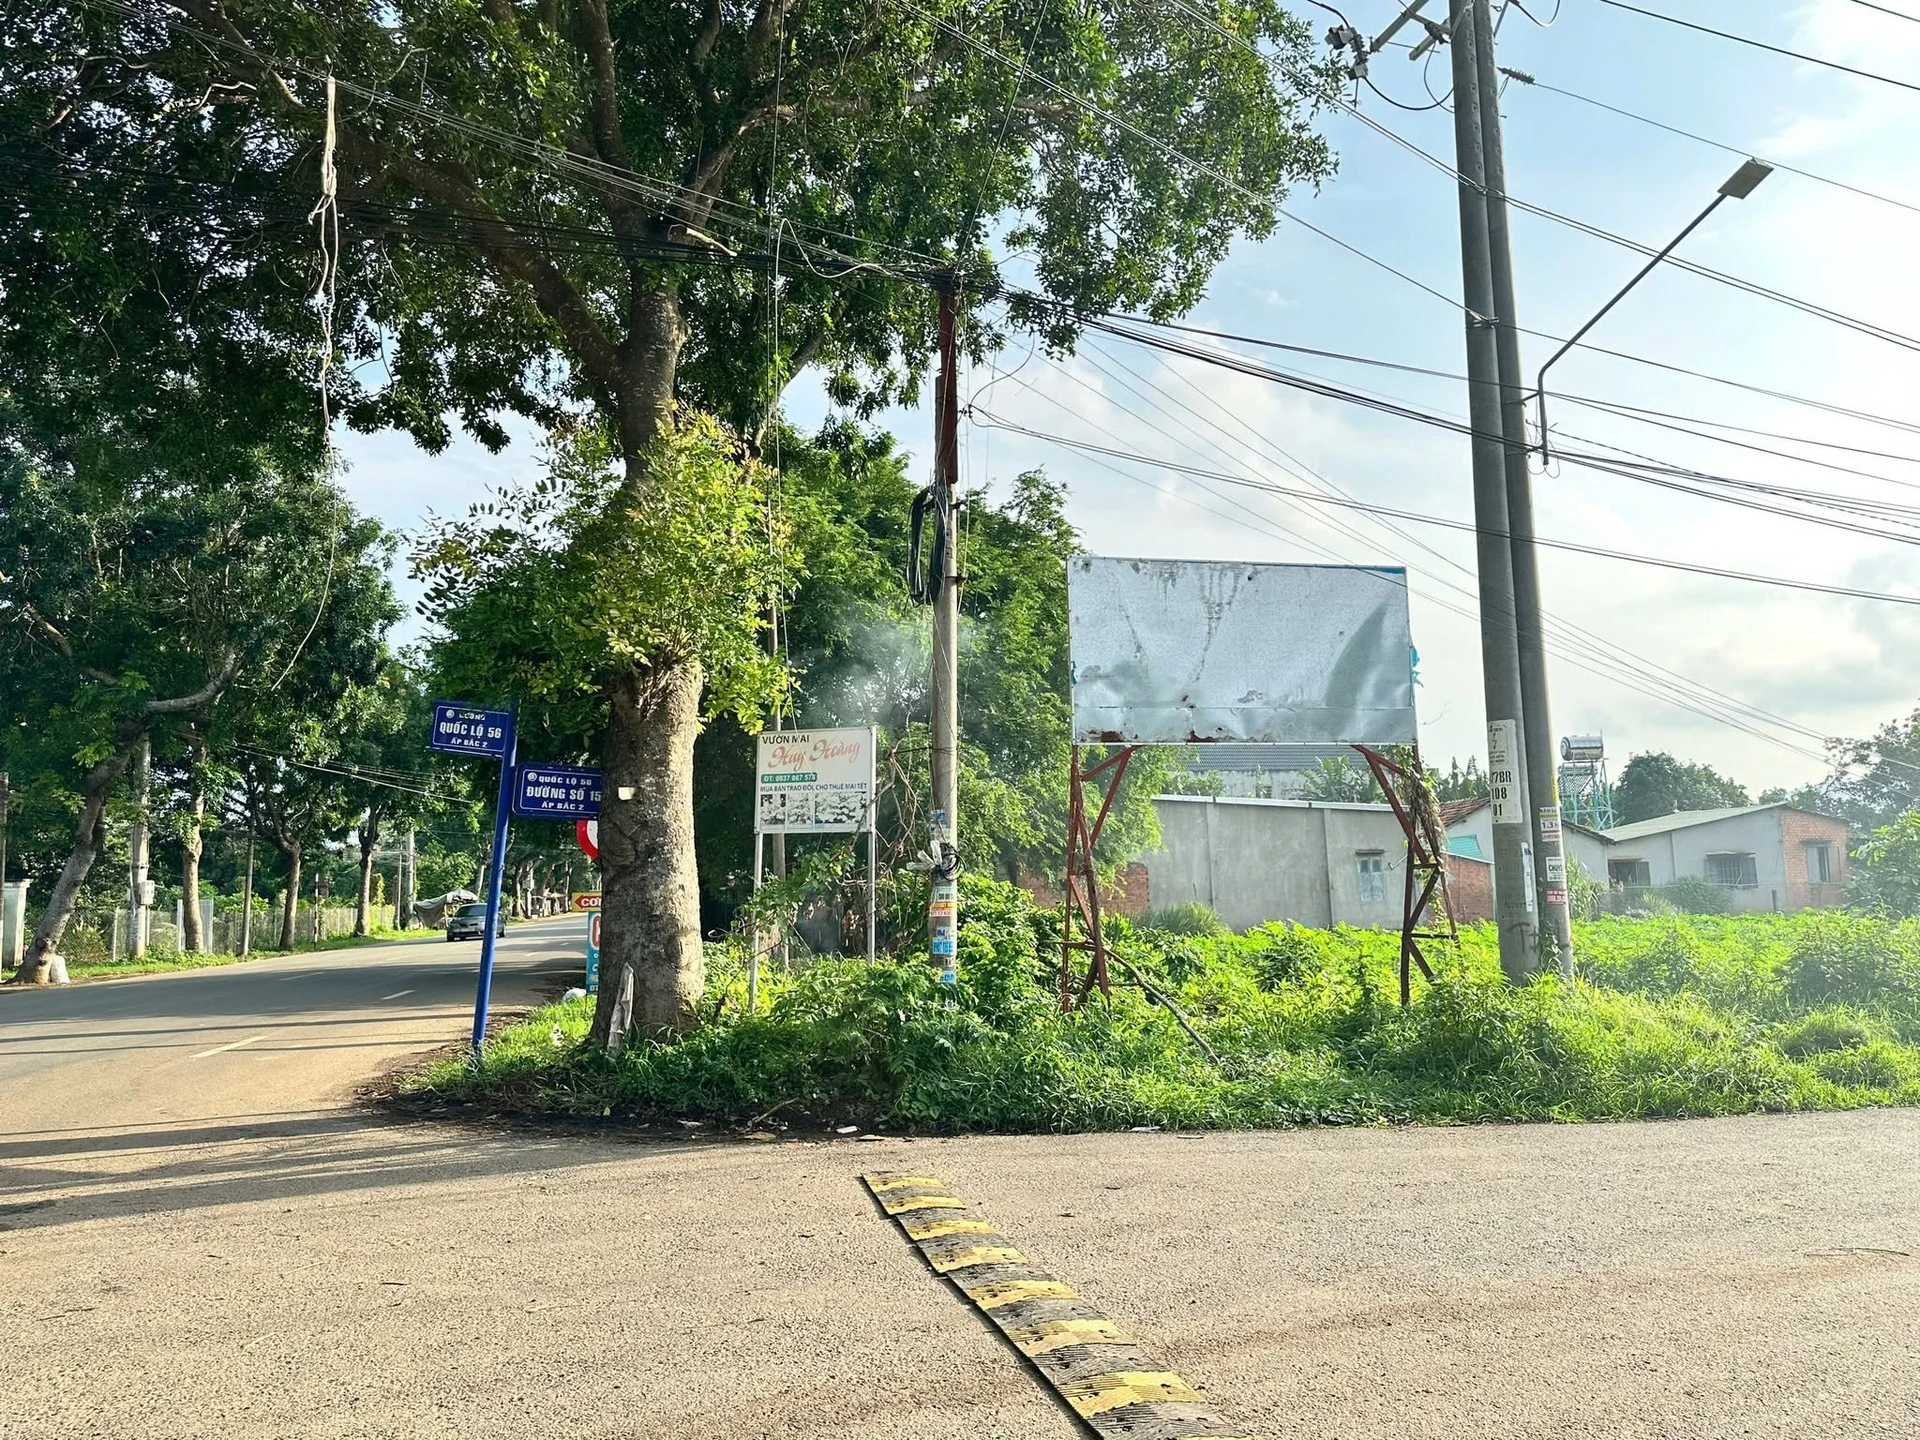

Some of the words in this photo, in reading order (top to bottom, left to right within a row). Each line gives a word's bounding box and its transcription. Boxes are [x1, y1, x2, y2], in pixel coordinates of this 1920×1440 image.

[440, 721, 468, 734] QUỐC
[470, 724, 484, 738] LỘ
[487, 727, 501, 738] 56
[762, 735, 790, 744] VƯỜN
[791, 735, 809, 743] MAI
[539, 775, 563, 783] QUỐC
[566, 778, 577, 786] LỘ
[526, 785, 566, 799] ĐƯỜNG
[570, 787, 585, 800] SỐ
